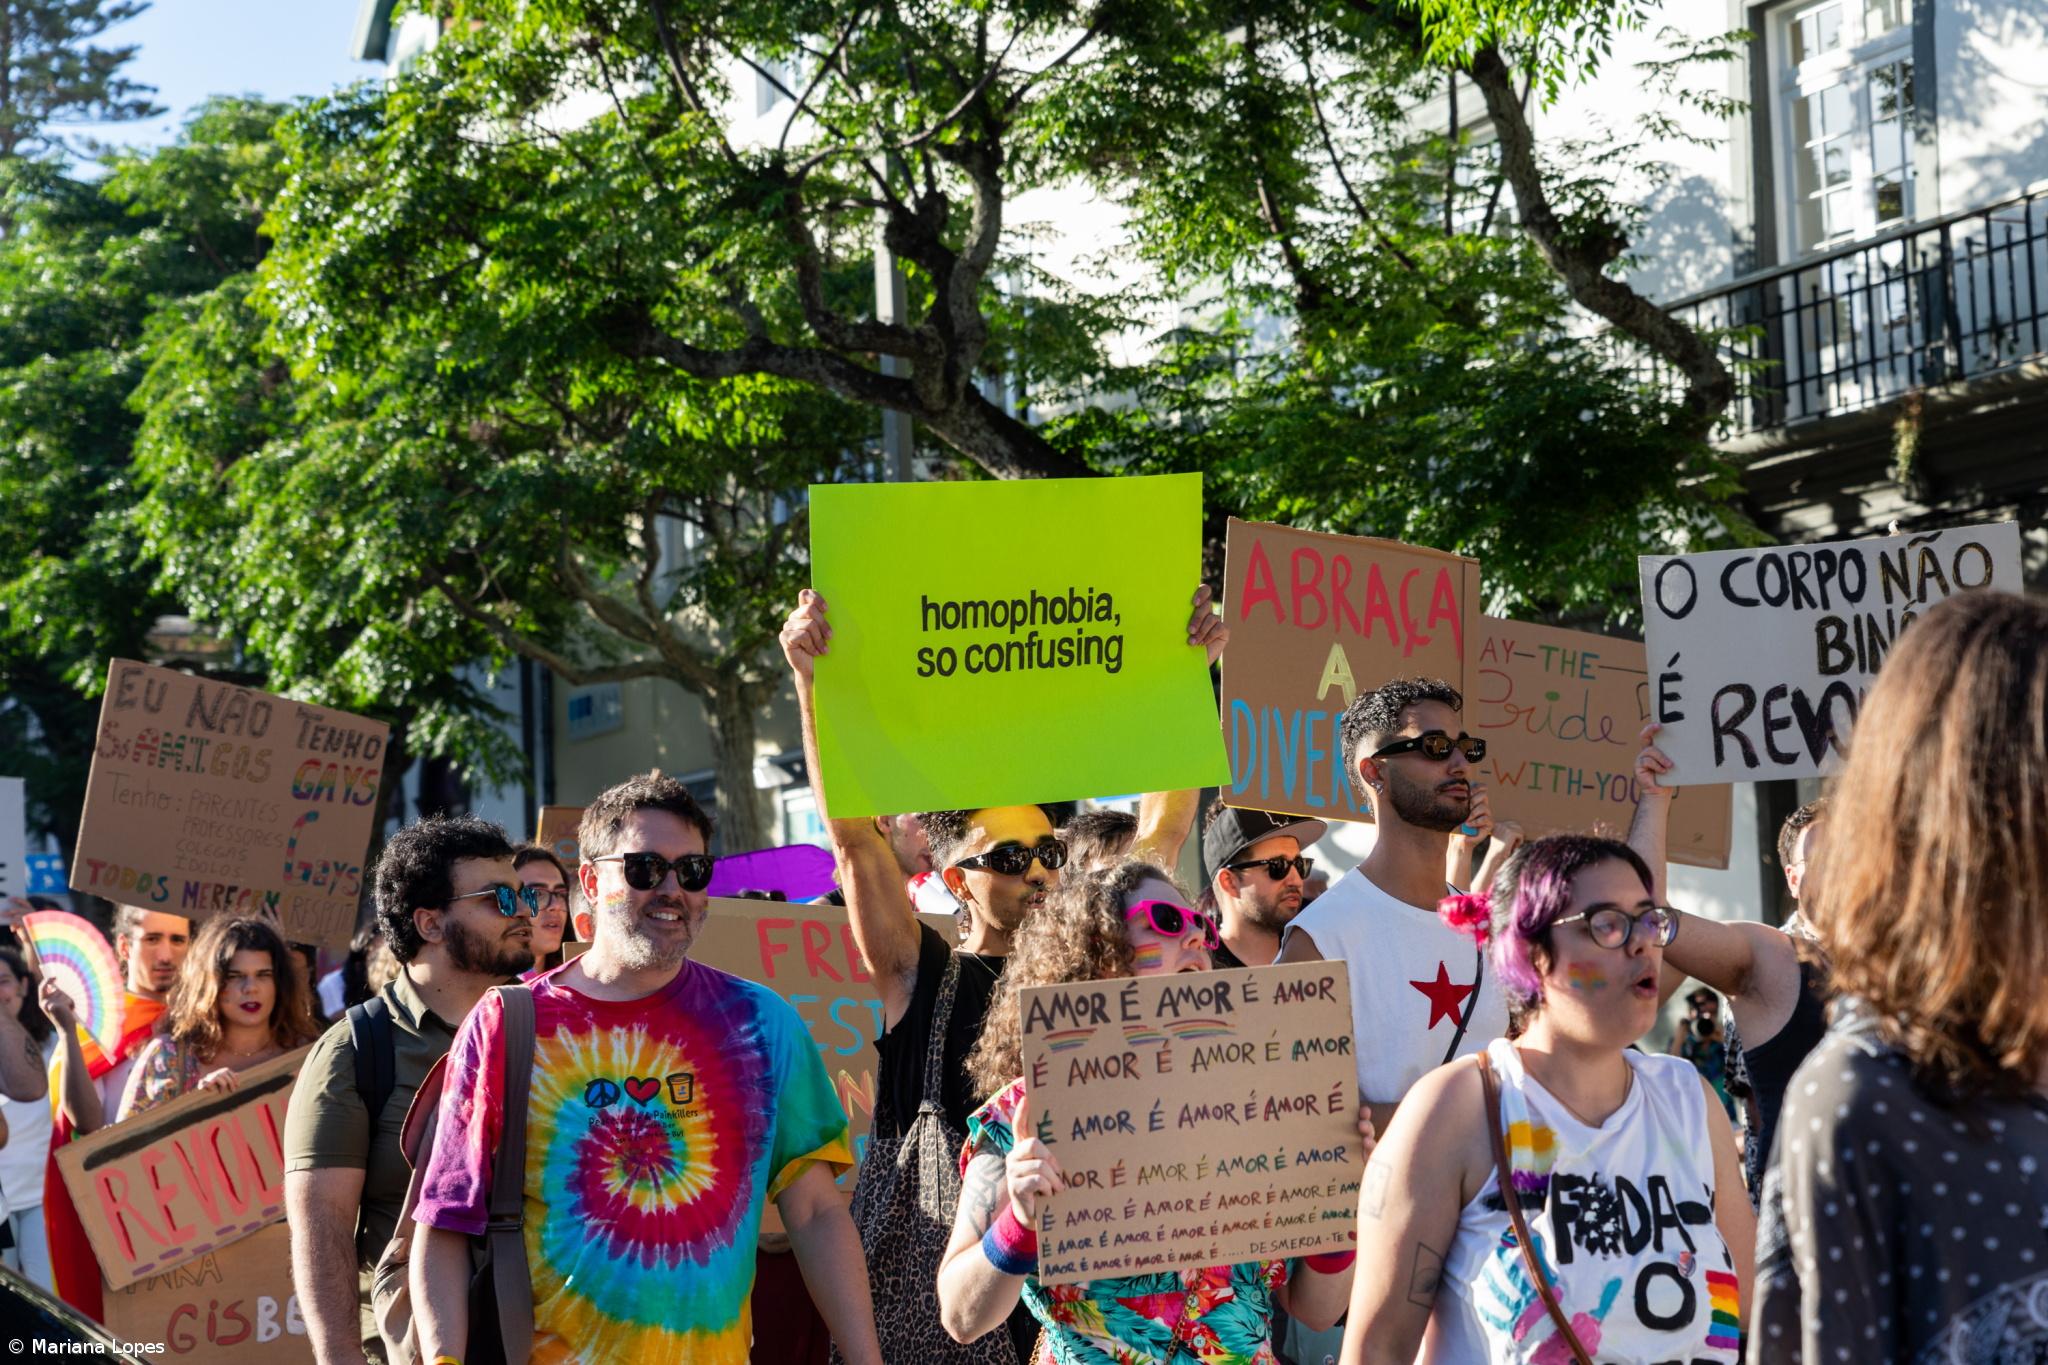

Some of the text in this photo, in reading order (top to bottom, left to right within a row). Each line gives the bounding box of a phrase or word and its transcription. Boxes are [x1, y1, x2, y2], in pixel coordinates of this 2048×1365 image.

[1240, 539, 1463, 660] ABRAÇA
[1655, 531, 1994, 620] O CORPO NÃO
[921, 587, 1120, 634] homophobia,
[917, 628, 1124, 677] so confusing
[1316, 642, 1356, 706] A
[114, 667, 381, 761] EU NÃO TENHO
[1659, 652, 1866, 769] É REVO
[292, 758, 379, 806] GAYS
[1231, 699, 1370, 813] DIVER
[183, 816, 285, 848] PROFESSORES
[188, 789, 281, 823] PARENTES
[86, 858, 170, 902] TODOS
[1025, 974, 1336, 1034] AMOR É AMOR É AMOR
[1032, 1029, 1350, 1088] É AMOR É AMOR É AMOR
[653, 1109, 698, 1120] Painkillers
[1037, 1081, 1344, 1145] É AMOR É AMOR É AMOR É
[1052, 1145, 1349, 1195] MOR É AMOR É AMOR É AMOR
[1042, 1178, 1360, 1232] É AMOR É AMOR É AMOR É AMOR É AMO
[1042, 1236, 1052, 1258] É
[1058, 1238, 1093, 1255] AMOR
[1099, 1230, 1109, 1248] É
[1114, 1231, 1152, 1247] AMOR
[1157, 1224, 1165, 1241] É
[1171, 1226, 1206, 1241] AMOR
[1210, 1220, 1218, 1235] É
[1222, 1219, 1259, 1234] AMOR
[1264, 1212, 1272, 1229] É
[1275, 1213, 1306, 1227] AMOR
[1308, 1206, 1317, 1223] É
[1322, 1208, 1351, 1220] AMOR
[1044, 1263, 1076, 1277] AMOR
[1080, 1257, 1088, 1271] É
[1093, 1257, 1121, 1270] AMOR
[1135, 1253, 1164, 1267] AMOR
[1179, 1249, 1205, 1263] AMOR
[1210, 1242, 1218, 1259] É
[1634, 1262, 1696, 1330] O
